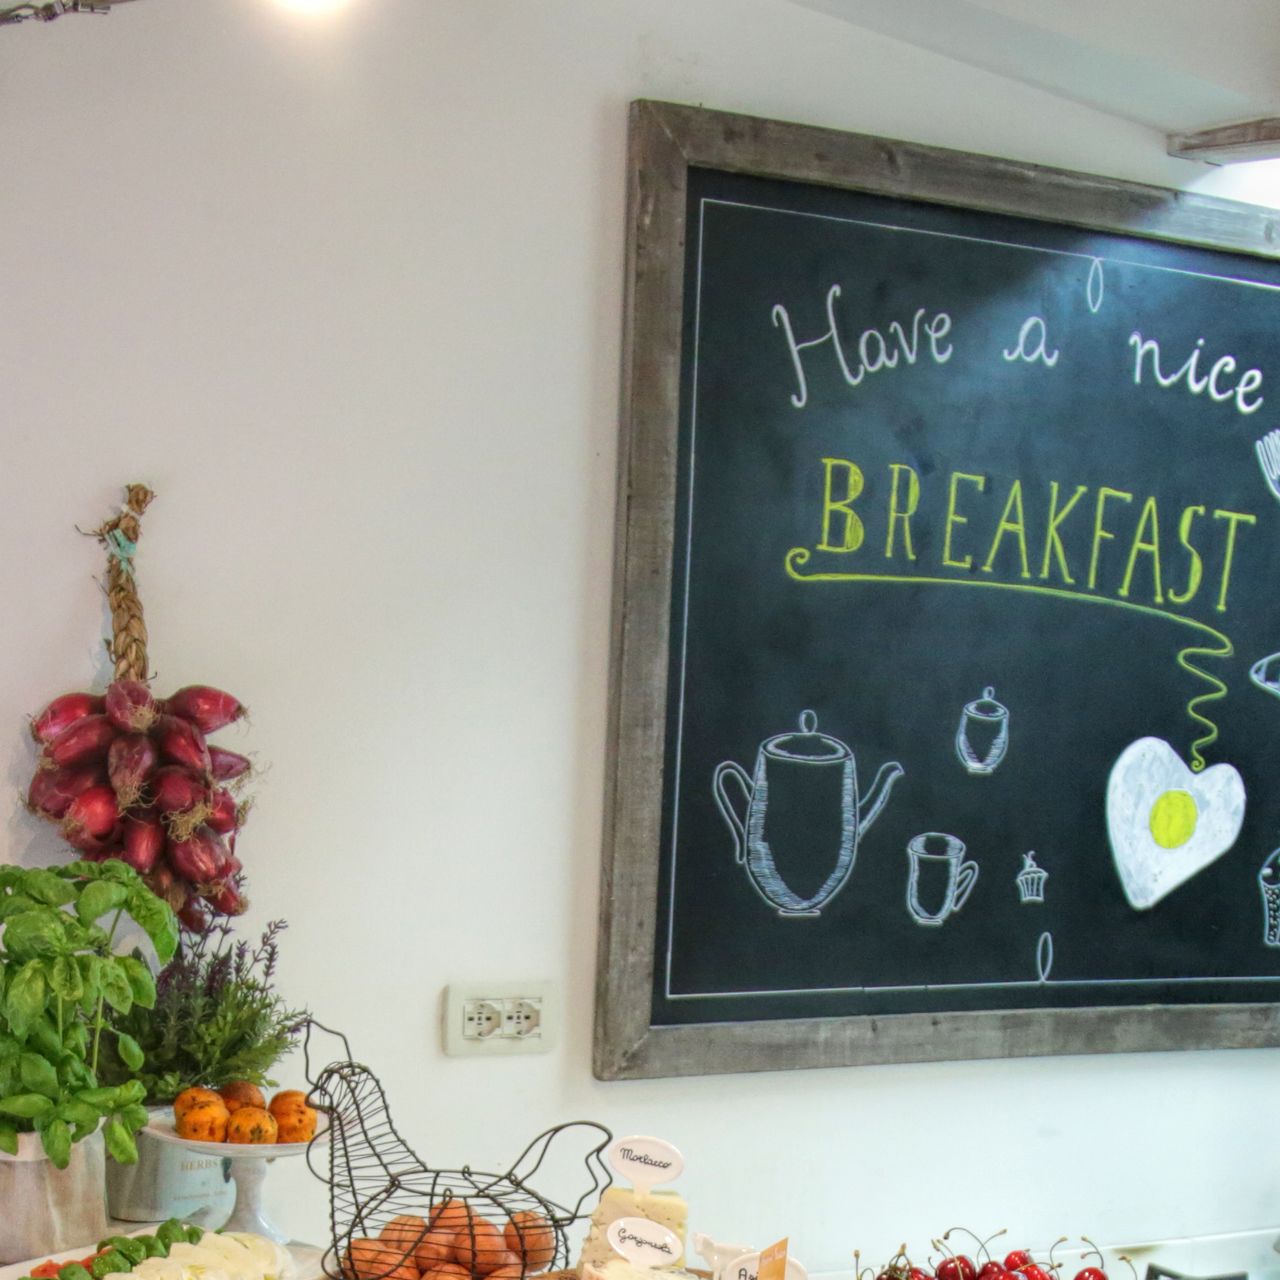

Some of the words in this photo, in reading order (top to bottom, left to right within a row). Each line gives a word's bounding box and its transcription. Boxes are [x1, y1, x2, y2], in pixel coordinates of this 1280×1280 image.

[772, 284, 953, 407] Have
[1003, 316, 1059, 367] a
[1129, 331, 1264, 414] nice
[816, 457, 1257, 612] BREAKFAST
[620, 1147, 672, 1169] Morlacco
